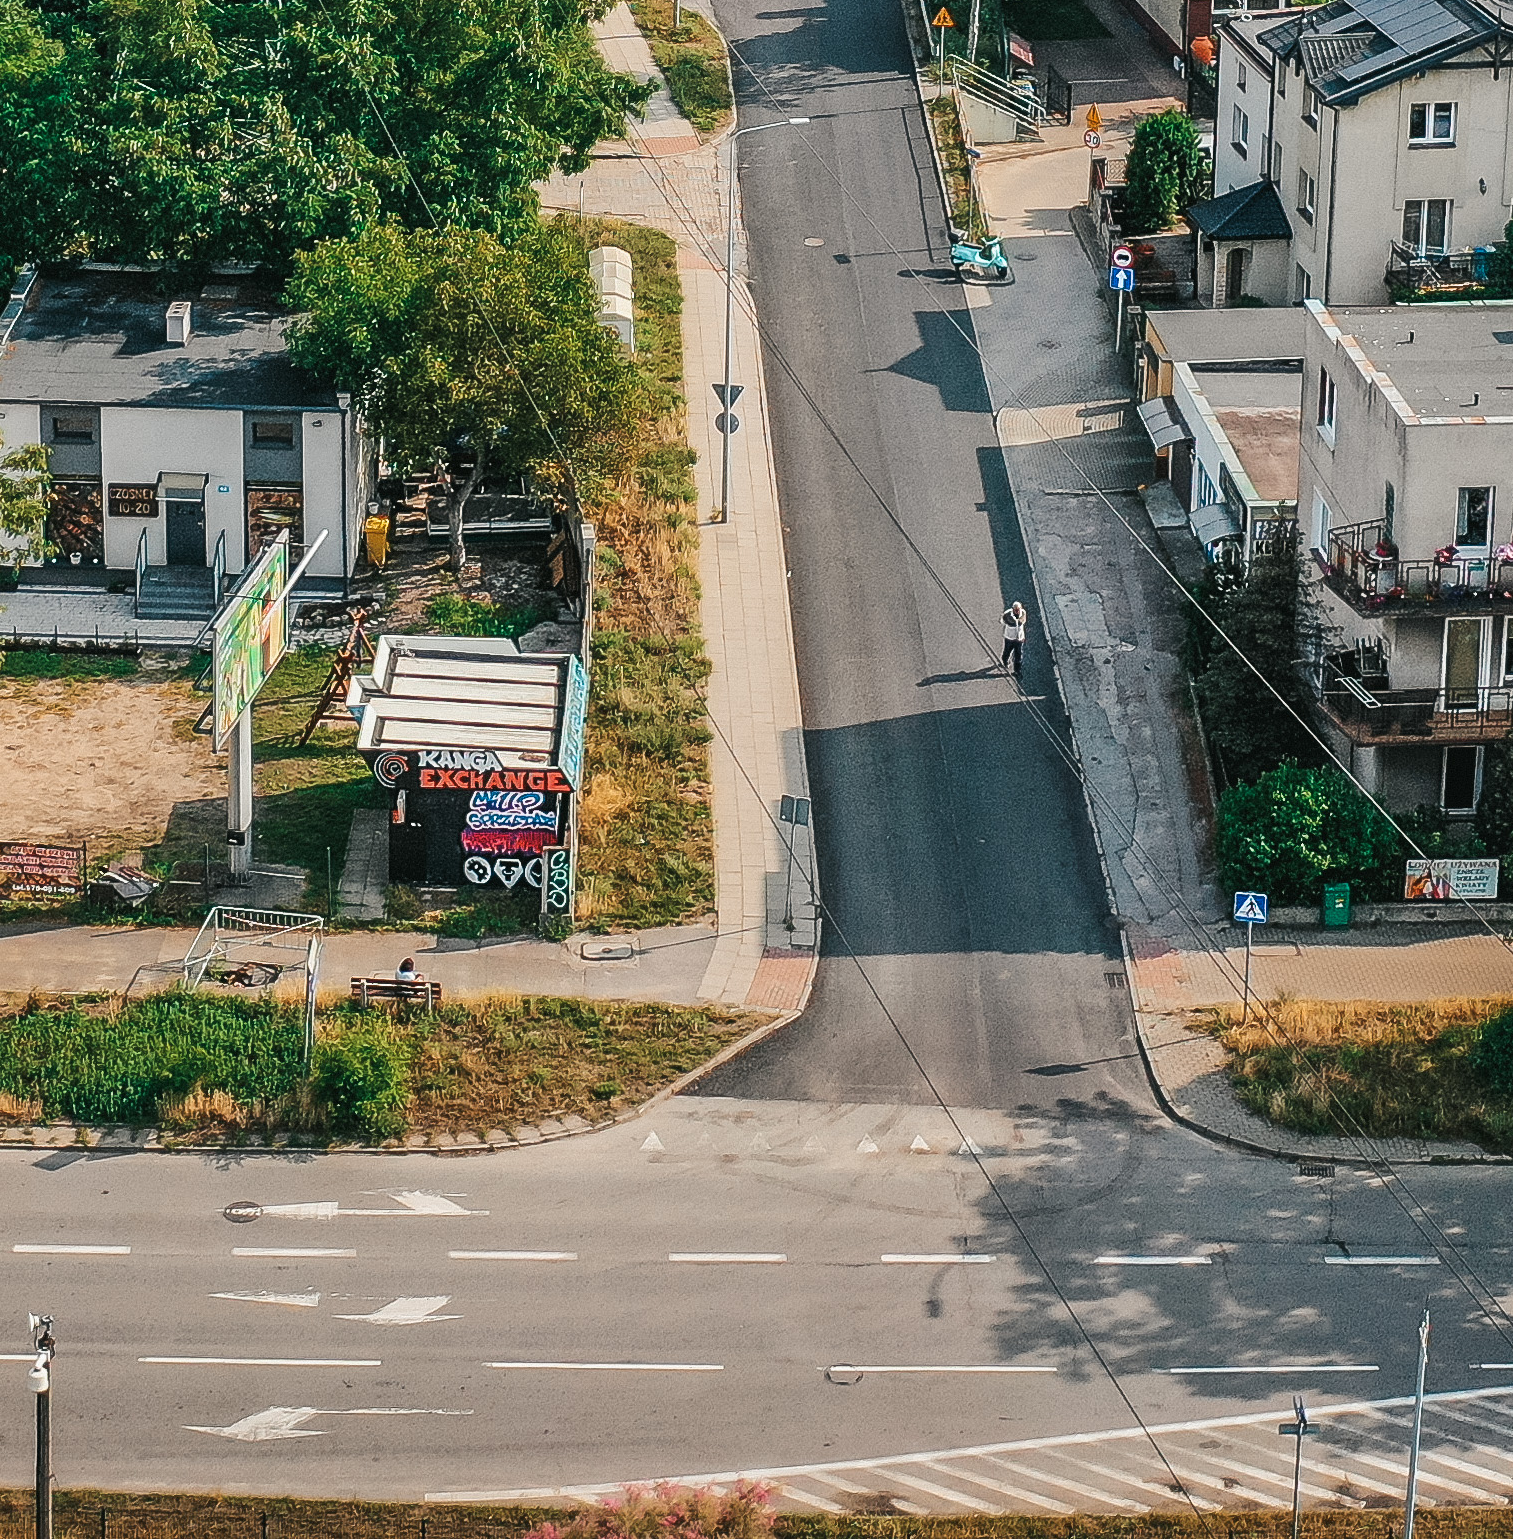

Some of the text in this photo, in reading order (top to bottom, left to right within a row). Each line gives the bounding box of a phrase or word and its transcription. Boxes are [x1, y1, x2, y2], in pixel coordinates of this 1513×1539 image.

[1086, 130, 1098, 145] 30
[118, 502, 150, 514] 10-20
[418, 751, 503, 773] KANGA
[419, 769, 571, 792] EXCHANGE
[1450, 861, 1498, 869] UŻYWANA
